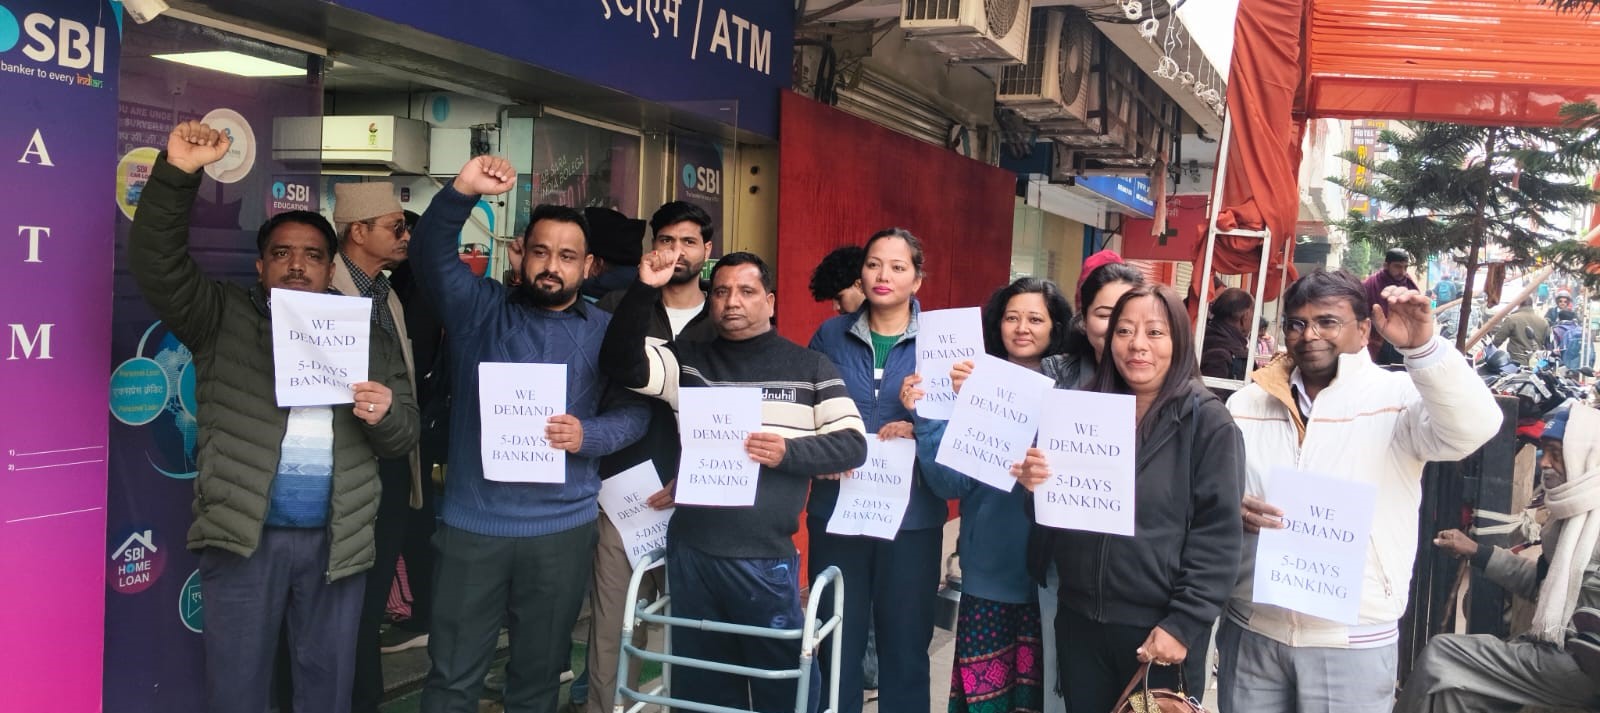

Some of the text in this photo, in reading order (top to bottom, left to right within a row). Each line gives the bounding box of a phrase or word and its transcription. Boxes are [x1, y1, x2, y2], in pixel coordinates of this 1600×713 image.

[22, 13, 105, 73] SBI
[709, 8, 771, 75] ATM
[0, 61, 34, 76] banker
[37, 68, 46, 78] to
[49, 71, 74, 85] every
[136, 165, 148, 173] SBI
[697, 166, 720, 195] SBI
[286, 184, 310, 202] SBI
[273, 201, 309, 211] EDUCATION
[312, 320, 335, 330] WE
[290, 330, 356, 346] DEMAND
[938, 333, 958, 344] WE
[922, 347, 976, 360] DEMAND
[298, 360, 348, 377] 5-DAYS
[930, 378, 950, 387] 5-D
[515, 390, 536, 401] WE
[926, 391, 958, 402] BANK
[996, 387, 1017, 404] WE
[494, 403, 554, 416] DEMAND
[969, 394, 1028, 424] DEMAND
[712, 414, 732, 425] WE
[1074, 422, 1099, 437] WE
[500, 434, 547, 447] 5-DAYS
[964, 426, 1012, 452] 5-DAYS
[1049, 438, 1121, 457] DEMAND
[492, 449, 554, 462] BANKING
[871, 457, 888, 469] WE
[952, 438, 1013, 474] BANKING
[698, 458, 743, 471] 5-DAYS
[689, 473, 748, 486] BANKING
[851, 470, 902, 485] DEMAND
[1055, 474, 1112, 492] 5-DAYS
[623, 492, 641, 504] WE
[852, 498, 891, 510] 5-DAYS
[1047, 491, 1121, 512] BANKING
[842, 510, 893, 524] BANKING
[1310, 505, 1337, 521] WE
[635, 520, 669, 541] 5-DAYS
[1280, 517, 1355, 543] DEMAND
[124, 546, 145, 562] SBI
[1281, 555, 1341, 578] 5-DAYS
[119, 573, 150, 587] LOAN
[1270, 569, 1348, 600] BANKING
